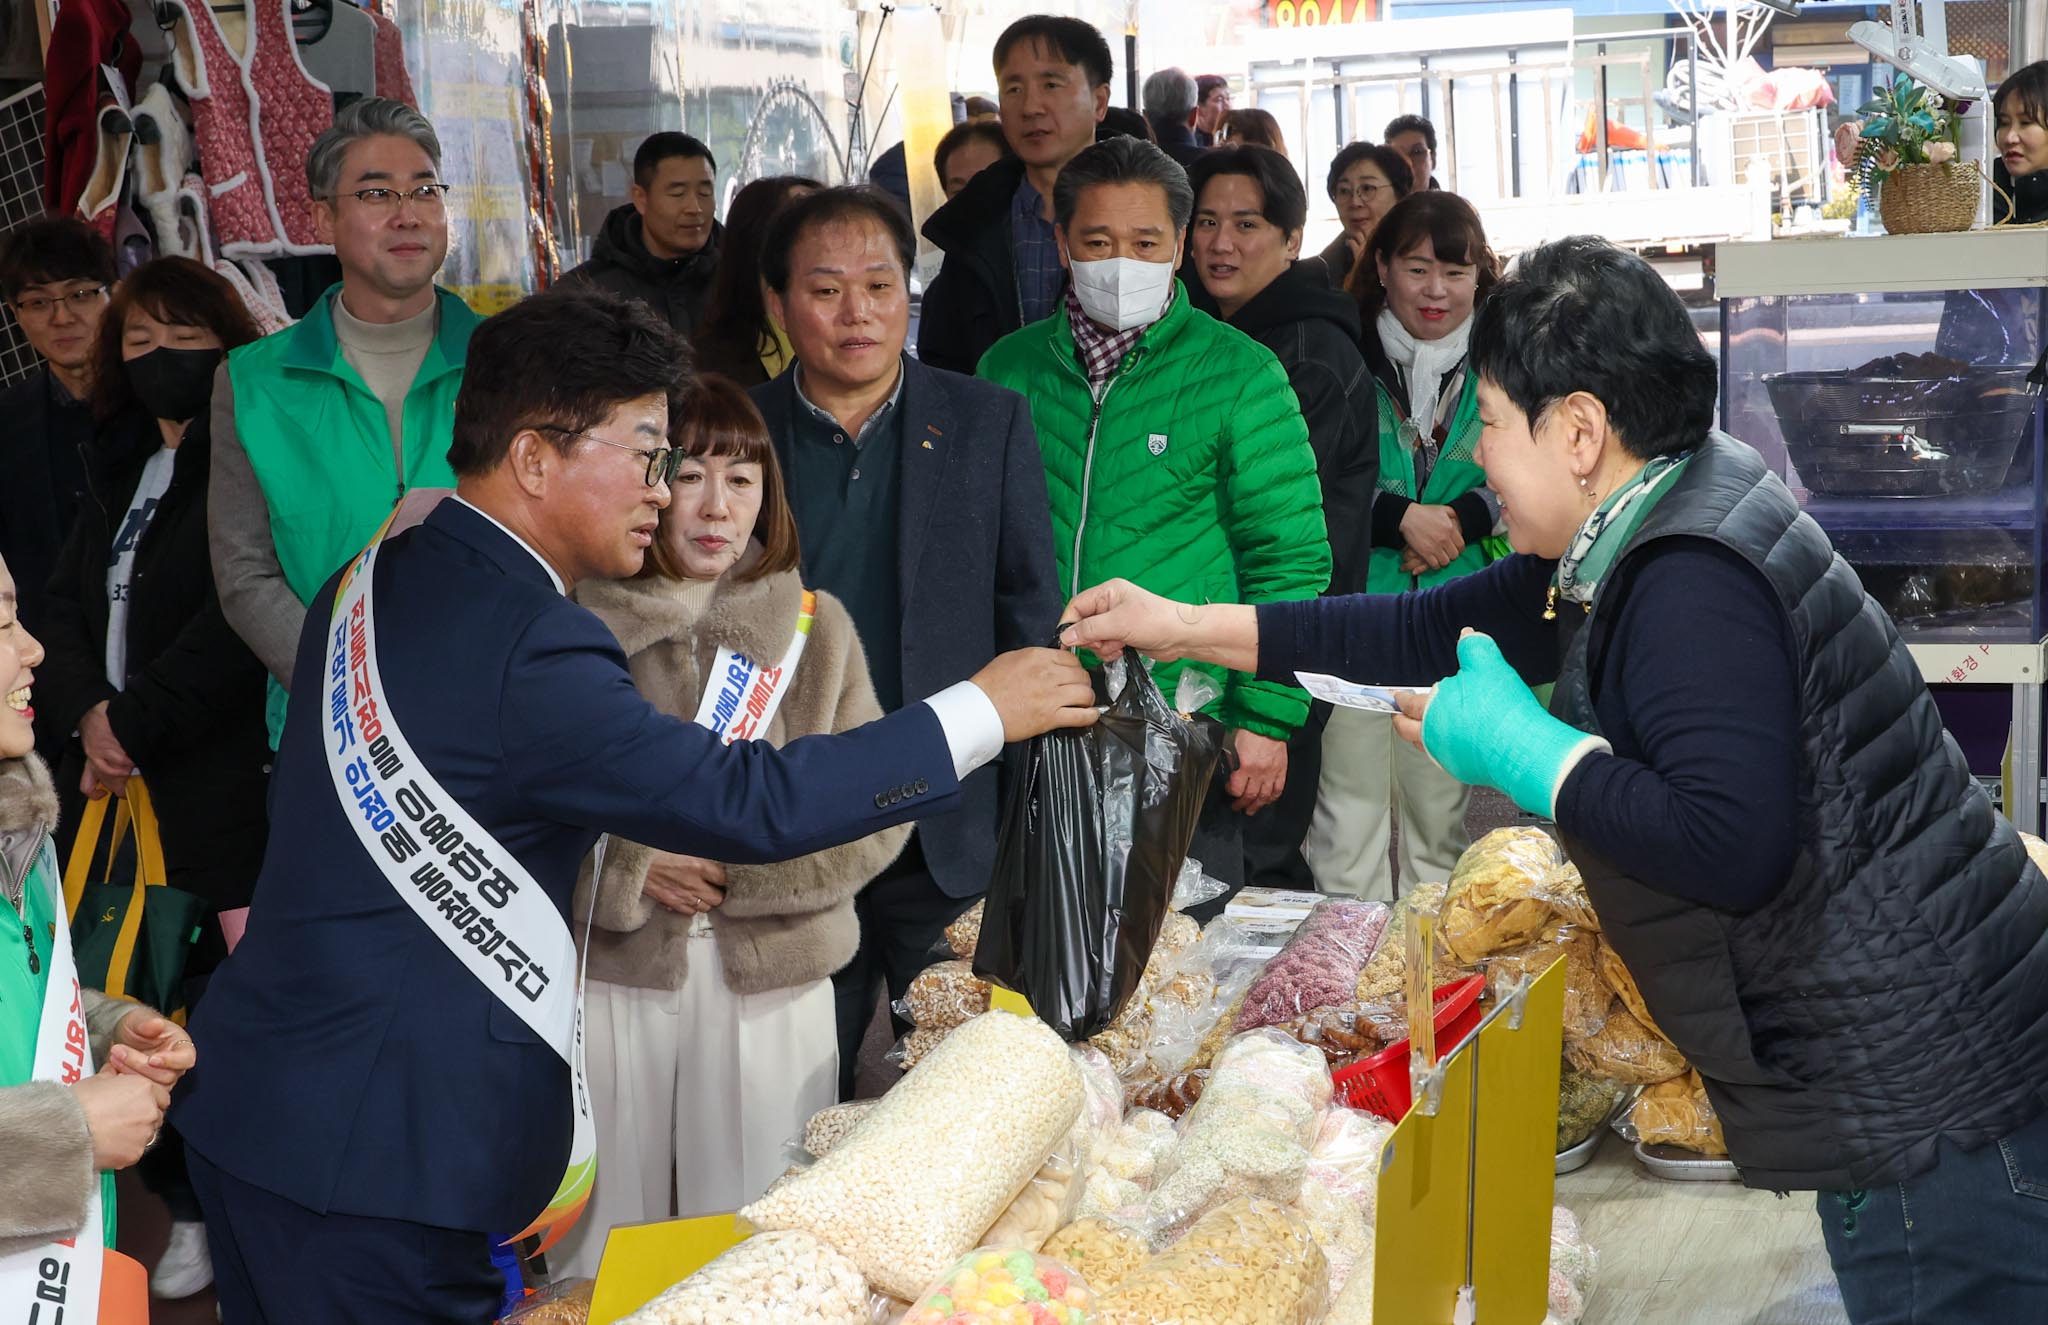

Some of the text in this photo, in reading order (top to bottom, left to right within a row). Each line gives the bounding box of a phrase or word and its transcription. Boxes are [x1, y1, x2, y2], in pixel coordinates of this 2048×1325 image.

[350, 593, 520, 909] 전통시장을 이용하여
[727, 665, 782, 743] 전통시
[345, 755, 422, 864] 안정에
[410, 861, 550, 1003] 동참합시다
